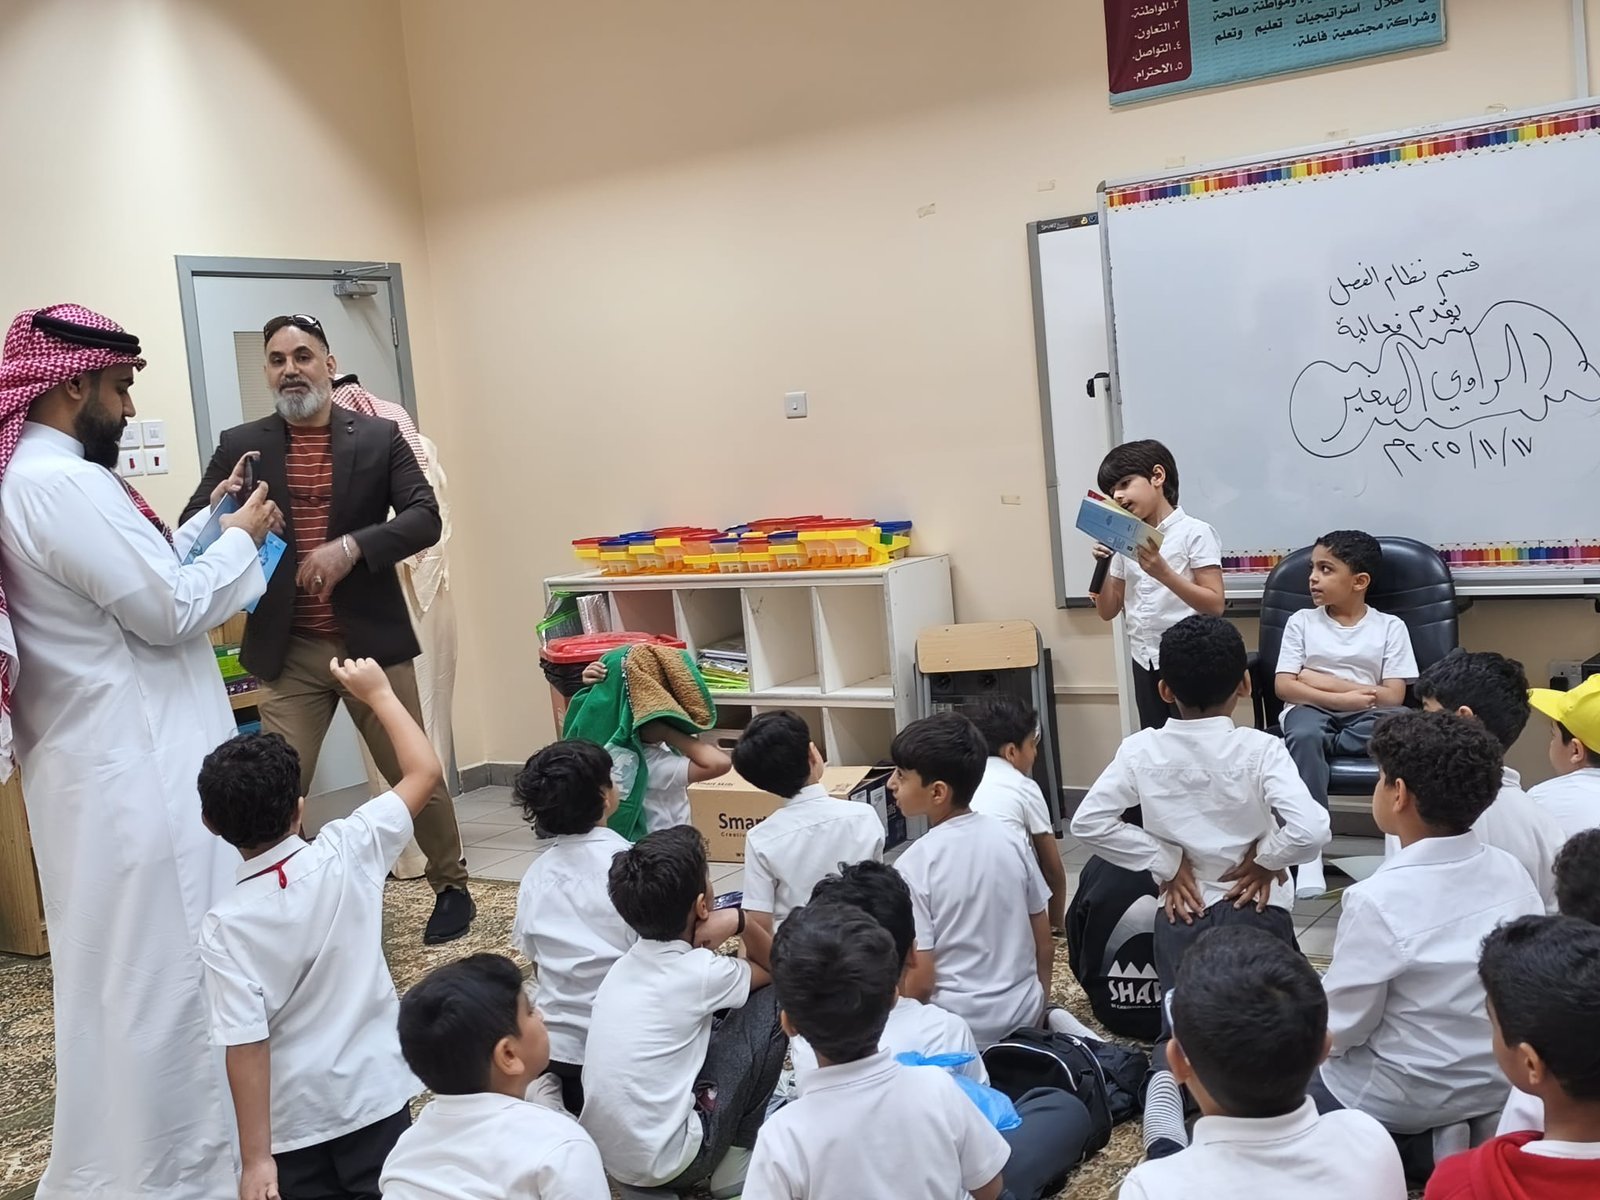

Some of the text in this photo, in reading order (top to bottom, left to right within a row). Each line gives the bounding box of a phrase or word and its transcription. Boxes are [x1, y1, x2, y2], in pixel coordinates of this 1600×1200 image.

[1130, 2, 1169, 19] المواطنة.
[1212, 6, 1249, 21] صالحة
[1295, 2, 1361, 25] استراتيجيات
[1134, 22, 1170, 40] التعاون.
[1214, 27, 1243, 45] وتعلم
[1254, 17, 1283, 37] تعليم
[1293, 11, 1437, 48] وشراكة مجتمعية فاعلة.
[1132, 43, 1172, 61] التواصل.
[1133, 62, 1173, 82] الاحترام.
[1328, 252, 1480, 306] قسم نظام الفصل
[1336, 298, 1461, 344] يقدم فعالية
[1320, 342, 1428, 443] الصغير
